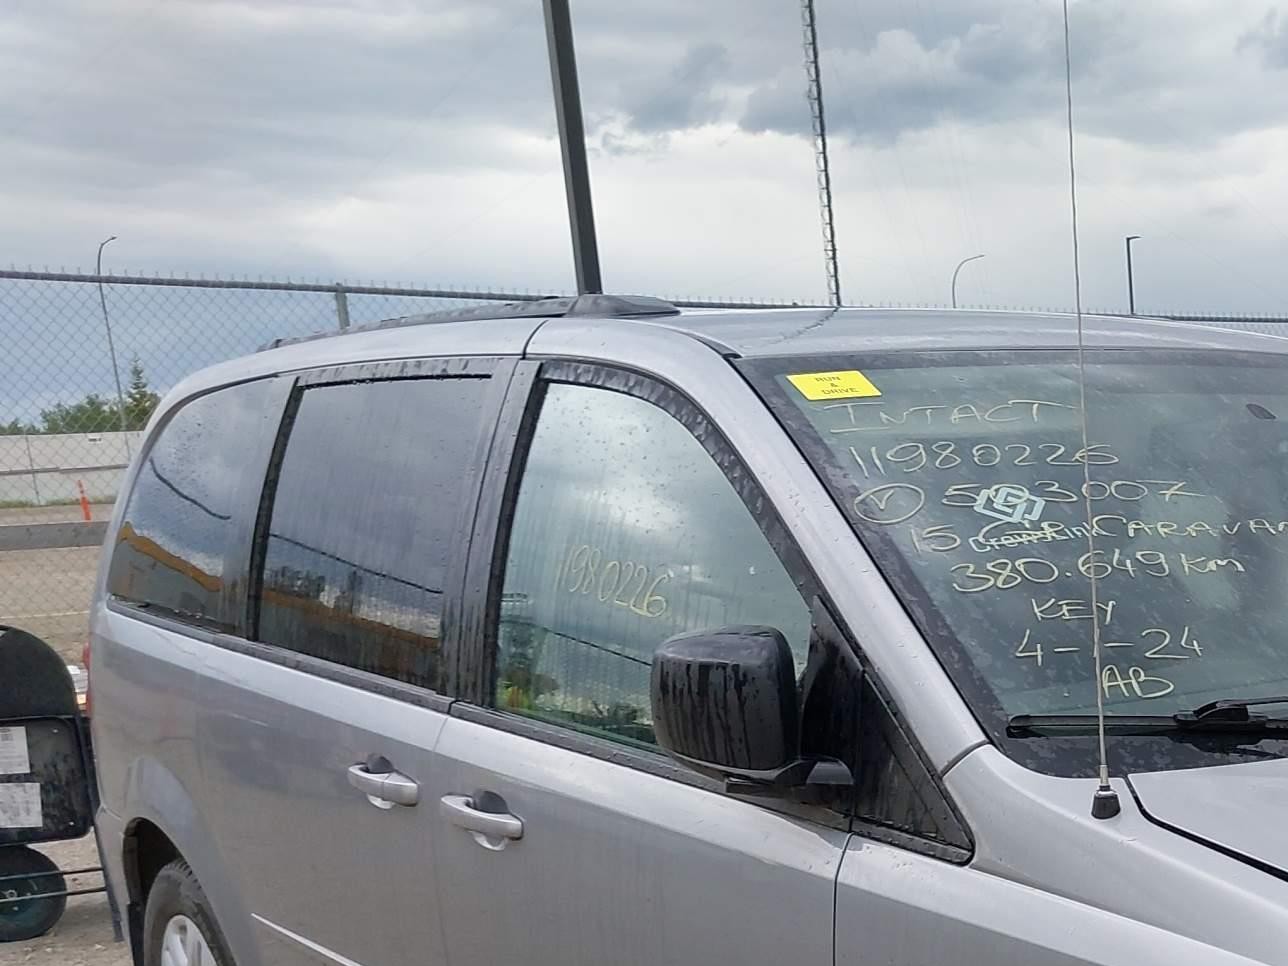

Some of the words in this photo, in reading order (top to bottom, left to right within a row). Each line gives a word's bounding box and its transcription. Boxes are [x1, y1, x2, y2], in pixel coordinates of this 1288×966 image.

[821, 387, 859, 395] DRIVE
[823, 399, 1076, 433] INTACT
[849, 441, 1119, 479] 11980226
[1032, 598, 1116, 625] KEY
